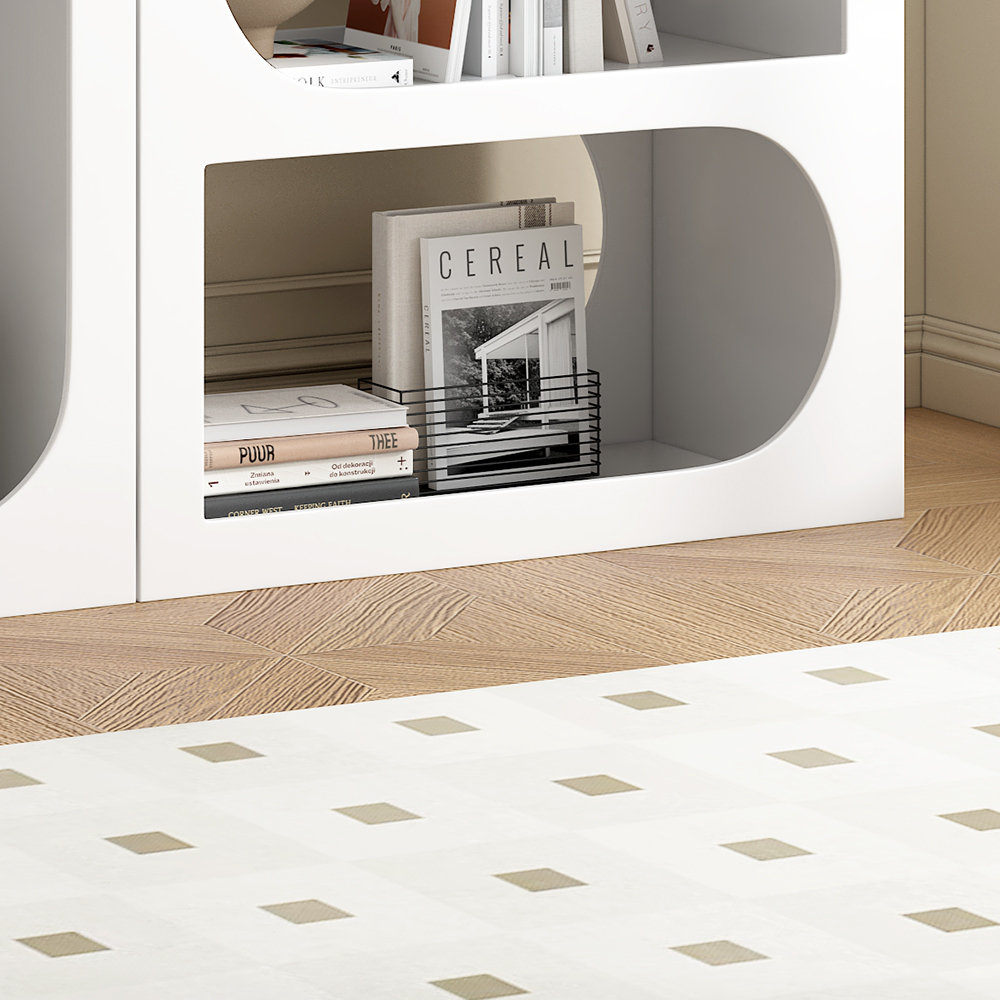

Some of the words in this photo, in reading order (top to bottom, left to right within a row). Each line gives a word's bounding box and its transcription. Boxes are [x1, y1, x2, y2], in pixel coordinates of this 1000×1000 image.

[439, 239, 574, 280] CEREAL
[368, 432, 399, 451] THEE
[238, 444, 275, 465] PUUR
[342, 460, 374, 469] dekoracji
[250, 471, 275, 479] Zmiana
[338, 468, 376, 477] konstrukcji
